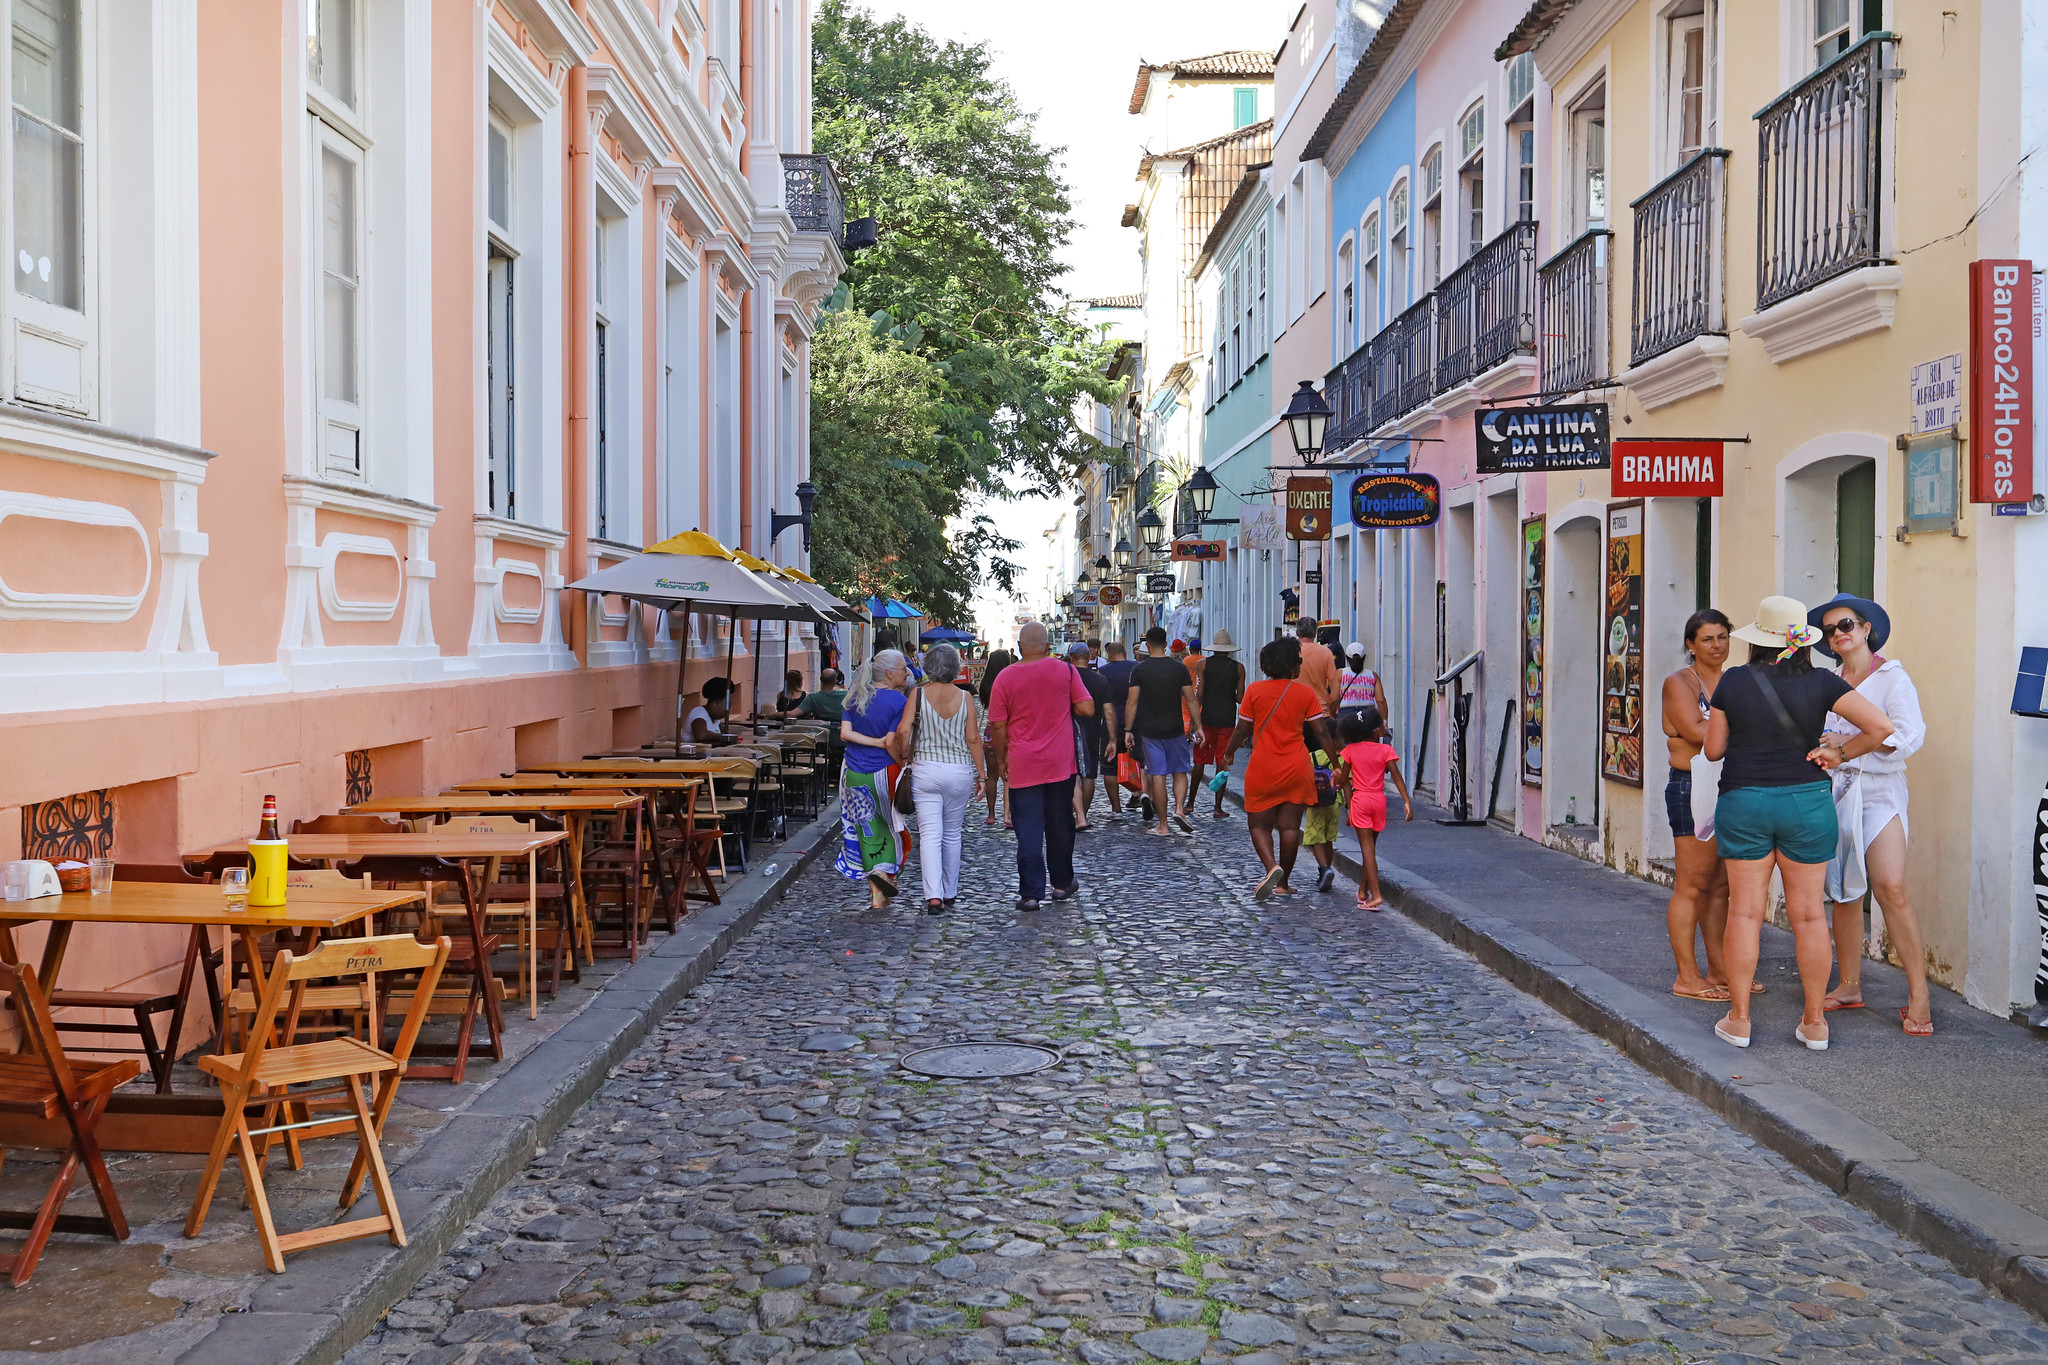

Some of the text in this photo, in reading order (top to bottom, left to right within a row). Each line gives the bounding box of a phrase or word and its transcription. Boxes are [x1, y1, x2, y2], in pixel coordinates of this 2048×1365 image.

[2032, 276, 2044, 338] Aqui tem
[1930, 362, 1941, 384] RUA
[1993, 265, 2020, 499] Banco24Horas
[1916, 379, 1956, 406] ALFREDO DE
[1925, 407, 1945, 428] BRITO
[1512, 435, 1585, 455] DA LUA
[1501, 456, 1534, 468] ANOS
[1622, 456, 1715, 482] BRAHMA
[1357, 476, 1423, 494] RESTAURANTE
[1289, 490, 1331, 510] OXENTE
[1360, 492, 1424, 517] Tropicália
[1360, 513, 1431, 526] LANCHONETE
[346, 956, 383, 969] PETRA
